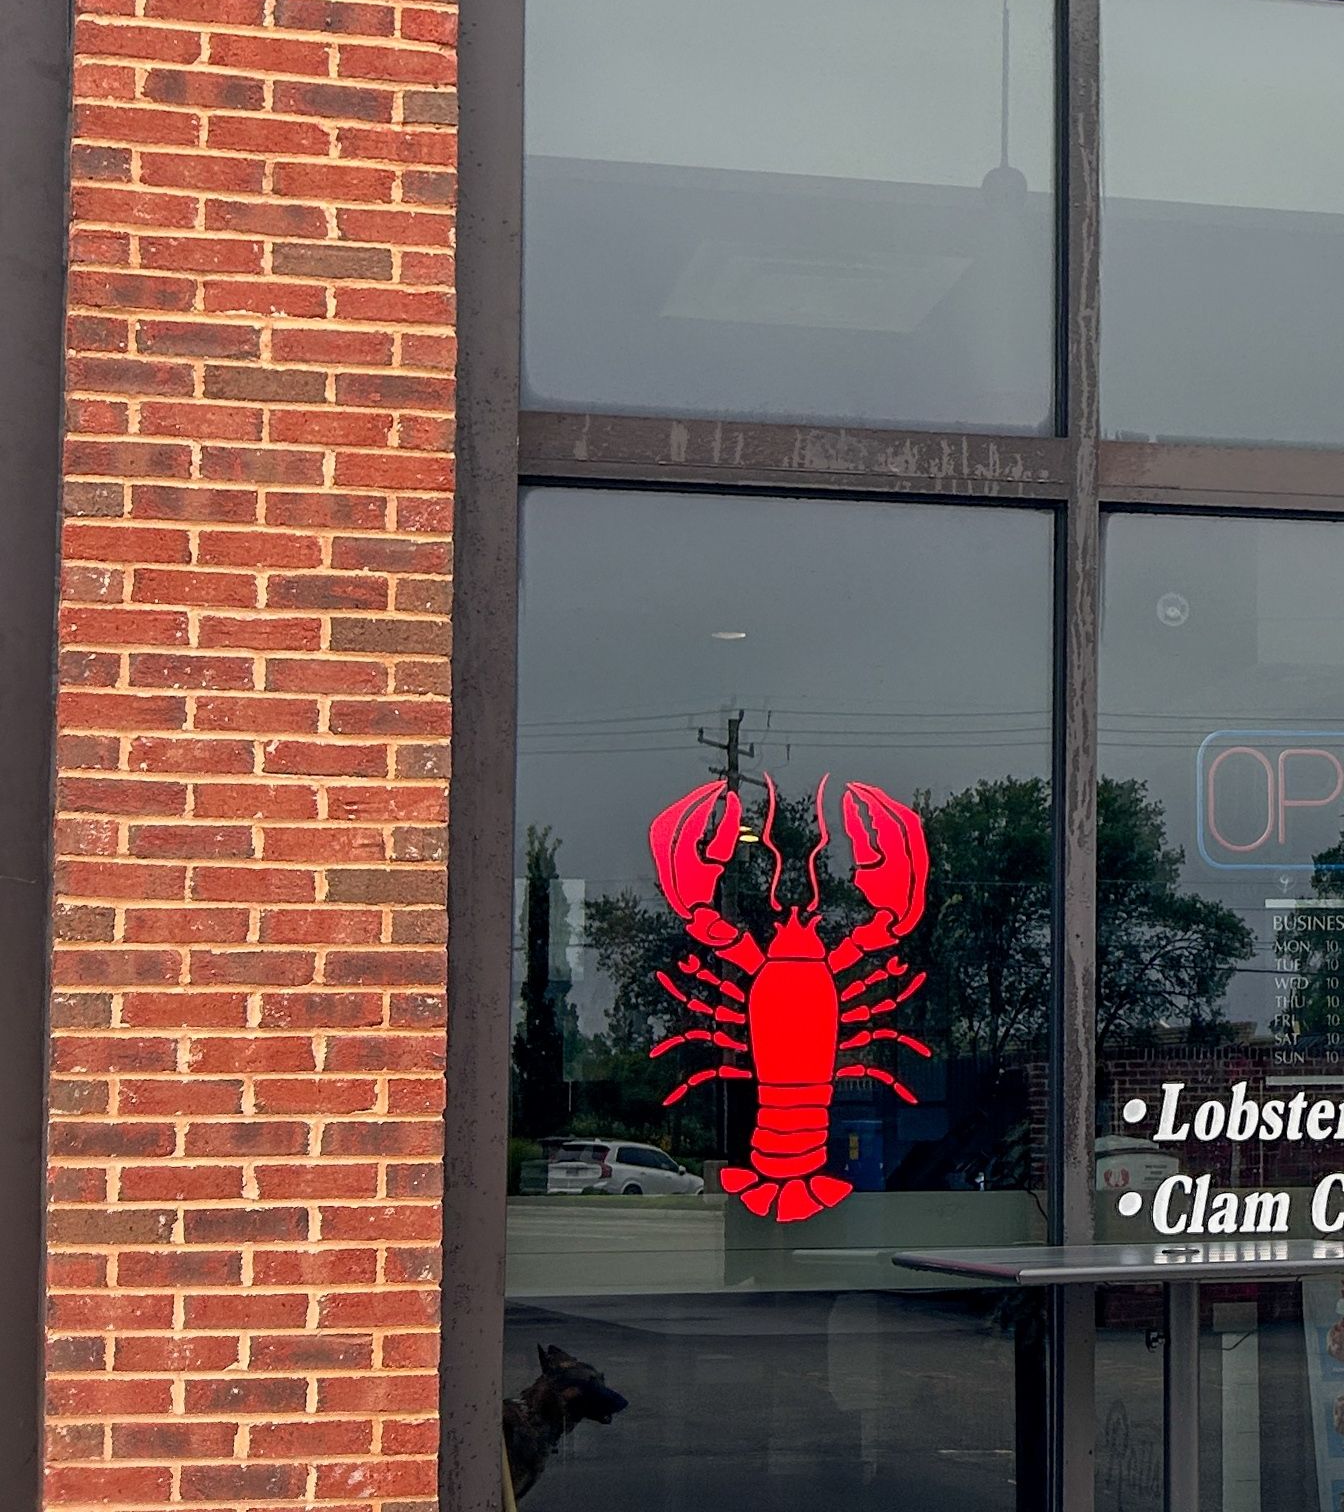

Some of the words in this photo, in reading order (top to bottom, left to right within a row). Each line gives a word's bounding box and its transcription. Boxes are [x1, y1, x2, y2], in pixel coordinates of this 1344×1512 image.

[1274, 940, 1311, 952] MON
[1275, 959, 1302, 970] TUE
[1275, 977, 1309, 989] WED
[1275, 996, 1306, 1007] THU
[1274, 1014, 1295, 1026] FRI
[1274, 1033, 1300, 1045] SAT
[1274, 1051, 1305, 1064] SUN
[1152, 1174, 1291, 1235] Clam
